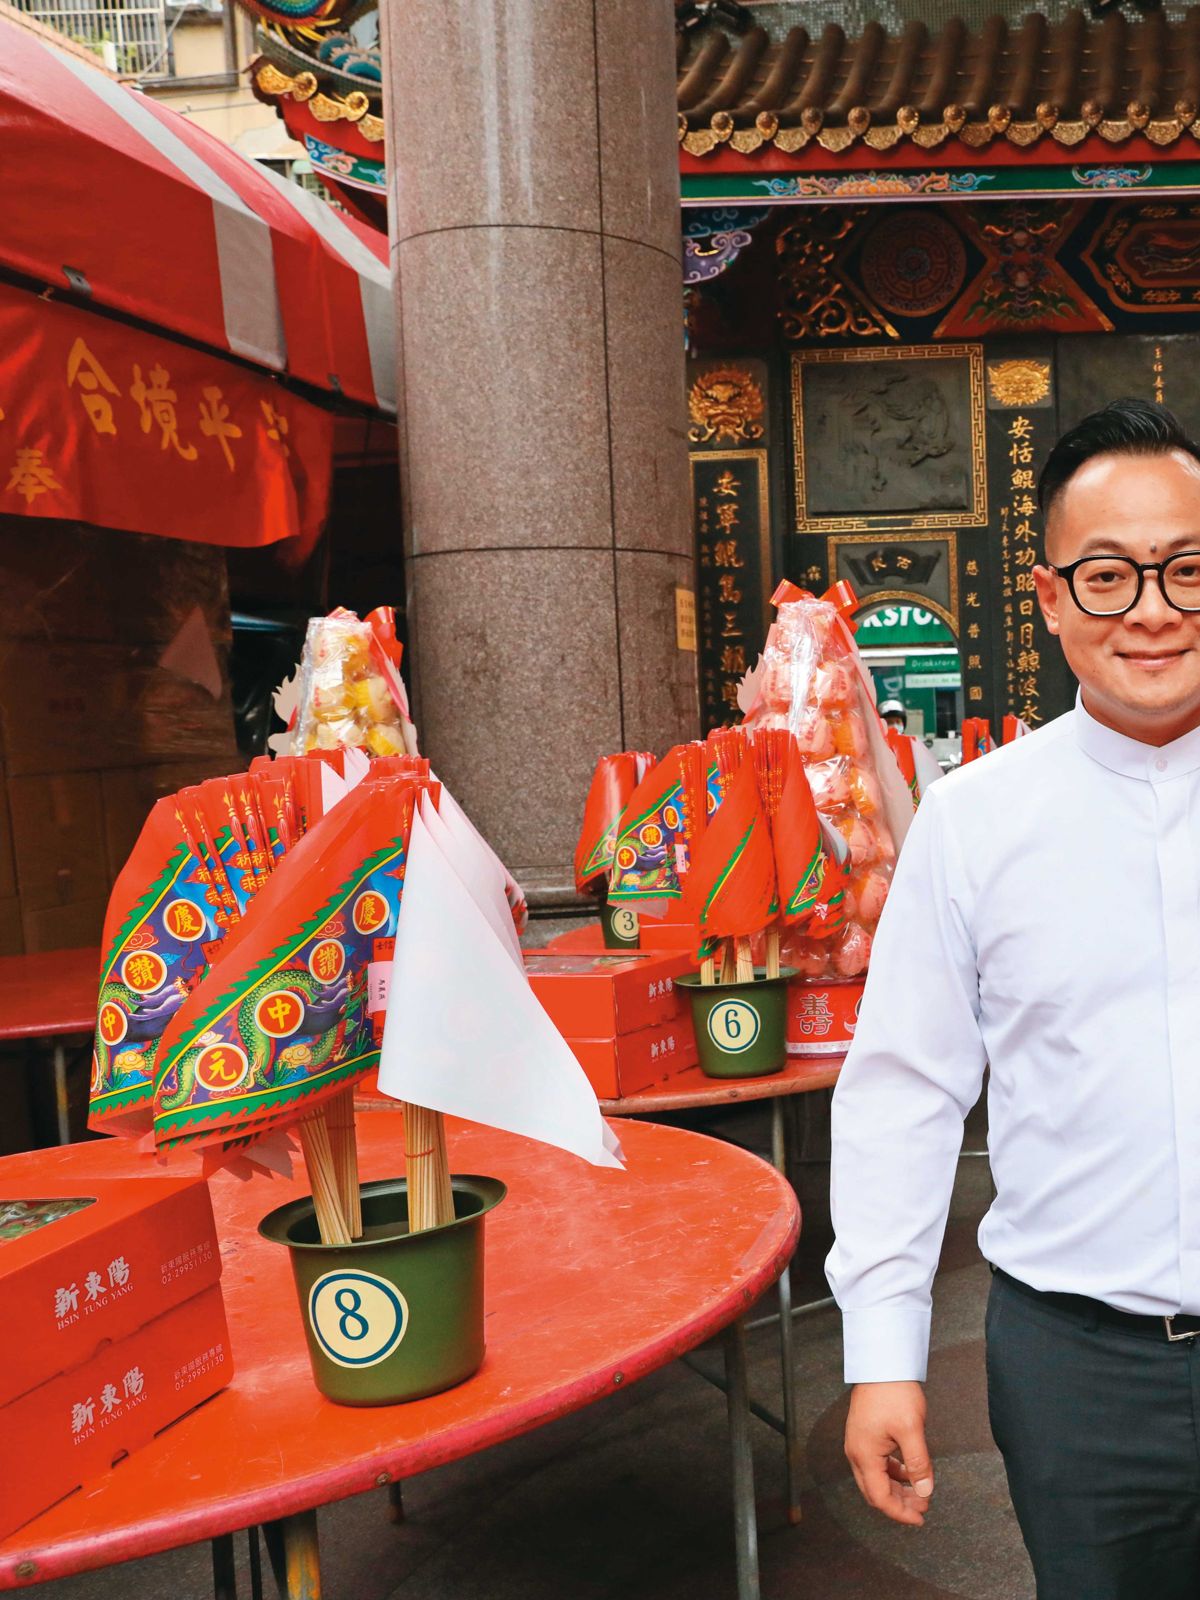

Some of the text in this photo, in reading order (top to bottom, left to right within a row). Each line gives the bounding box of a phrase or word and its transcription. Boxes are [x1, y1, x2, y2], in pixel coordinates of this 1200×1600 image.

[622, 910, 635, 931] 3
[724, 1008, 742, 1039] 6
[54, 1255, 131, 1319] 新東陽
[57, 1282, 135, 1331] HSIN TUNG YANG
[333, 1287, 370, 1342] 8
[71, 1365, 145, 1434] 新東陽
[73, 1391, 149, 1447] HSIN TUNG YANG
